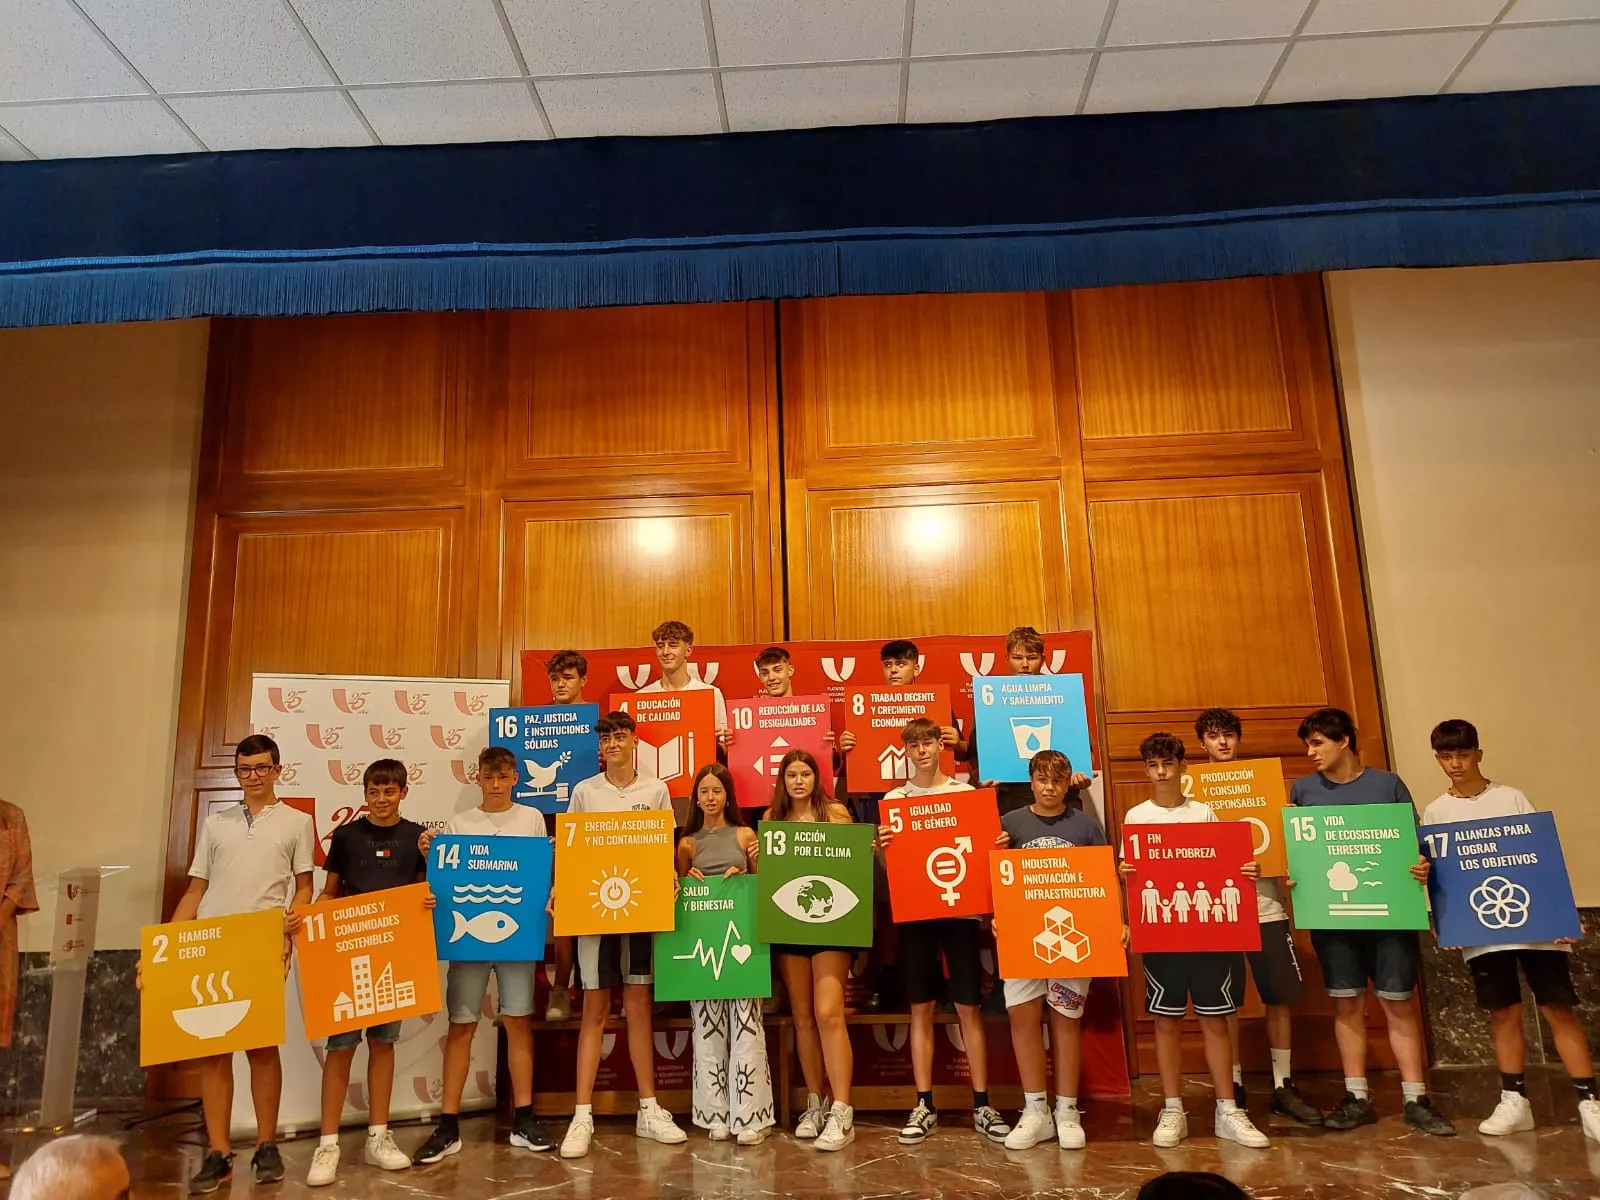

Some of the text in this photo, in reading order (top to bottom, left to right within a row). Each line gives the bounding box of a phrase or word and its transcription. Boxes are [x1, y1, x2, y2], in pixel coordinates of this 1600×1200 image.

[1002, 683, 1052, 693] AGUA LIMPIA
[870, 692, 935, 702] TRABAJO DECENTE
[982, 684, 994, 706] 6
[1002, 696, 1064, 705] Y SANEAMIENTO
[637, 697, 680, 710] EDUCACIÓN
[758, 702, 825, 716] REDUCCIÓN DE LAS
[852, 694, 864, 716] 8
[871, 705, 926, 714] Y CRECIMIENTO
[524, 713, 577, 724] PAZ, JUSTICIA
[637, 712, 680, 722] DE CALIDAD
[732, 707, 752, 730] 10
[760, 717, 816, 728] DESIGUALDADES
[872, 716, 914, 728] ECONÓMIC
[496, 715, 518, 738] 16
[524, 724, 590, 736] E INSTITUCIONES
[524, 738, 558, 750] SÓLIDAS
[1200, 768, 1254, 783] PRODUCCIÓN
[1180, 774, 1195, 798] 2
[1202, 784, 1250, 797] Y CONSUMO
[910, 803, 952, 816] IGUALDAD
[585, 818, 664, 832] ENERGÍA ASEQUIBLE
[888, 808, 903, 832] 5
[912, 816, 957, 831] DE GÉNERO
[1324, 816, 1344, 826] VIDA
[564, 822, 576, 847] 7
[1290, 816, 1316, 842] 15
[1326, 828, 1400, 840] DE ECOSISTEMAS
[1455, 824, 1532, 842] ALIANZAS PARA
[585, 834, 668, 846] Y NO CONTAMINANTE
[794, 830, 826, 842] ACCIÓN
[1148, 834, 1162, 844] FIN
[470, 844, 489, 855] VIDA
[764, 830, 786, 856] 13
[1129, 834, 1140, 860] 1
[1424, 832, 1449, 858] 17
[1458, 842, 1498, 856] LOGRAR
[794, 846, 851, 858] POR EL CLIMA
[1149, 848, 1216, 860] DE LA POBREZA
[1327, 844, 1382, 856] TERRESTRES
[436, 844, 460, 870] 14
[1460, 852, 1538, 870] LOS OBJETIVOS
[468, 859, 518, 870] SUBMARINA
[1022, 858, 1070, 870] INDUSTRIA,
[1000, 860, 1014, 886] 9
[1024, 871, 1084, 884] INNOVACIÓN E
[683, 886, 709, 896] SALUD
[1025, 887, 1106, 900] INFRAESTRUCTURA
[333, 902, 386, 921] CIUDADES Y
[684, 900, 734, 911] Y BIENESTAR
[303, 913, 325, 942] 11
[334, 914, 400, 937] COMUNIDADES
[178, 927, 222, 944] HAMBRE
[336, 932, 394, 952] SOSTENIBLES
[152, 935, 168, 963] 2
[178, 946, 206, 960] CERO
